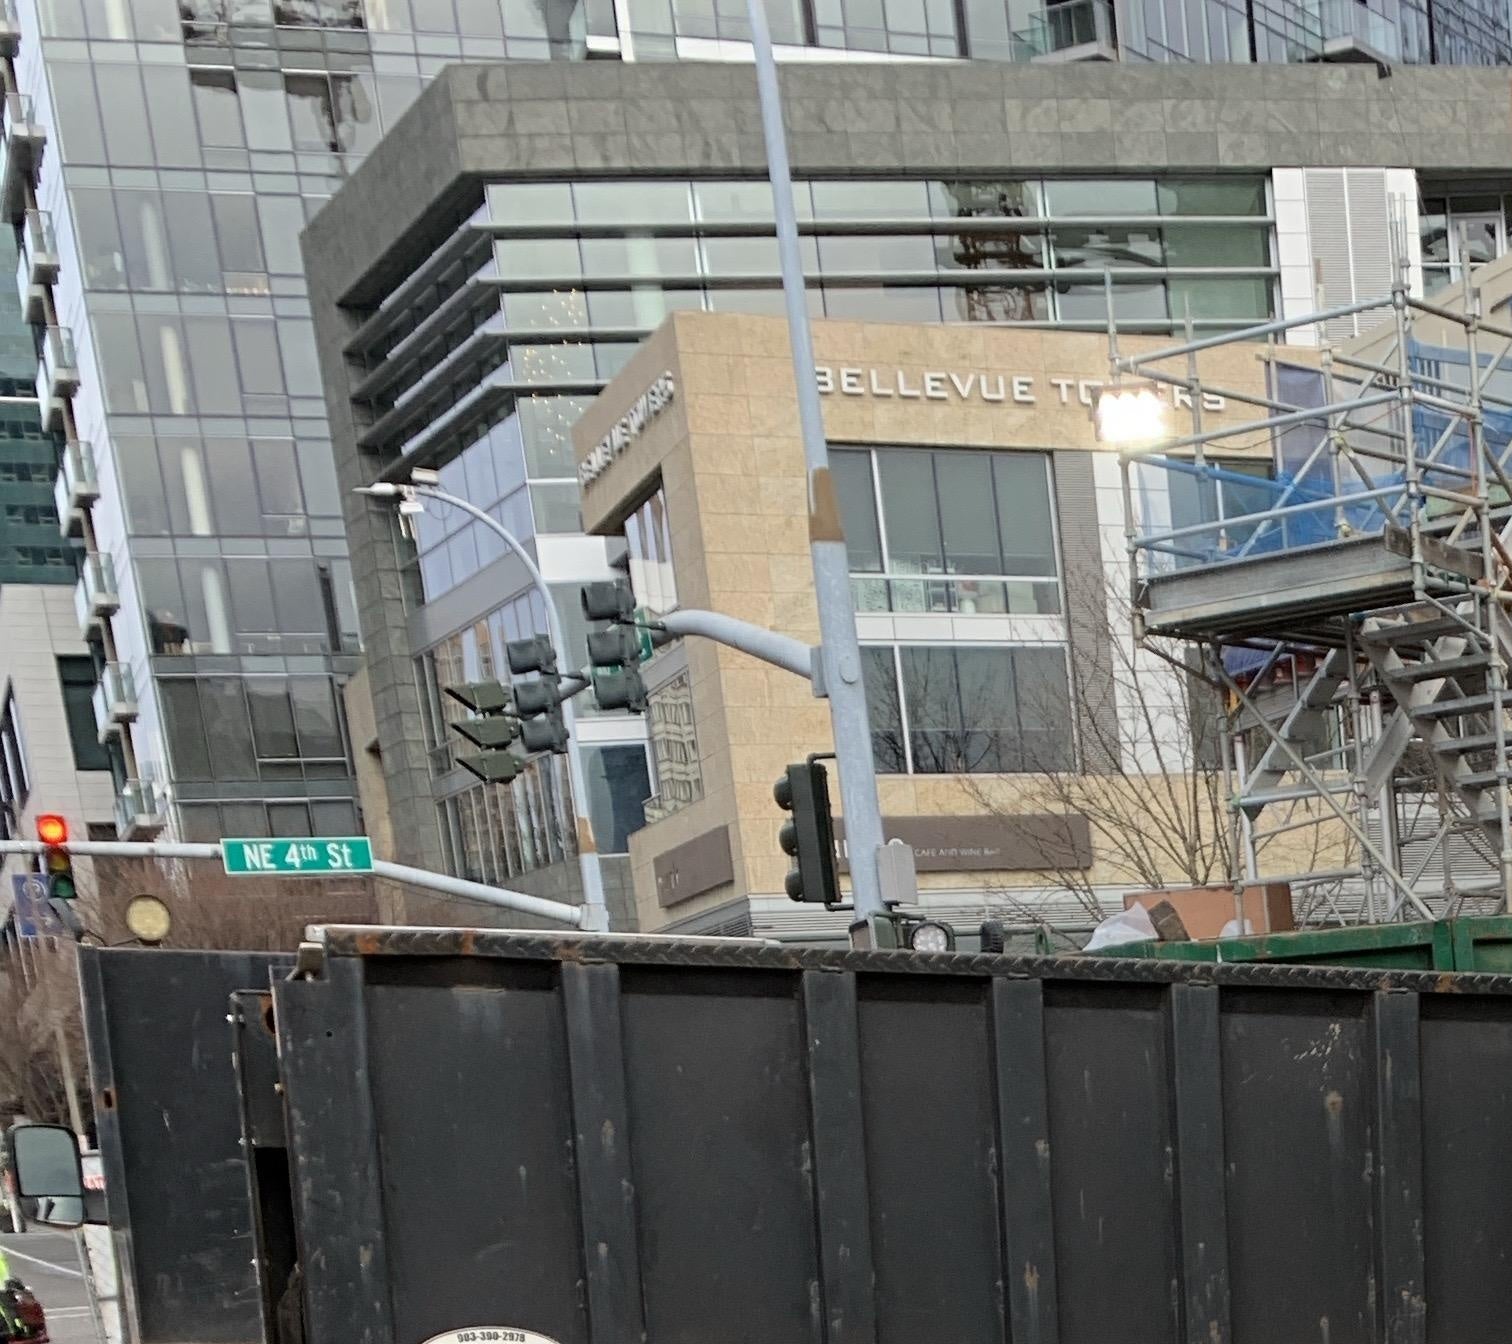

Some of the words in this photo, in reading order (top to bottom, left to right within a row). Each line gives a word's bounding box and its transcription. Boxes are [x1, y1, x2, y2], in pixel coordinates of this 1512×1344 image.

[815, 366, 1036, 402] BELLEVUE
[242, 843, 277, 870] NE
[284, 843, 318, 869] 4th
[326, 842, 353, 868] St
